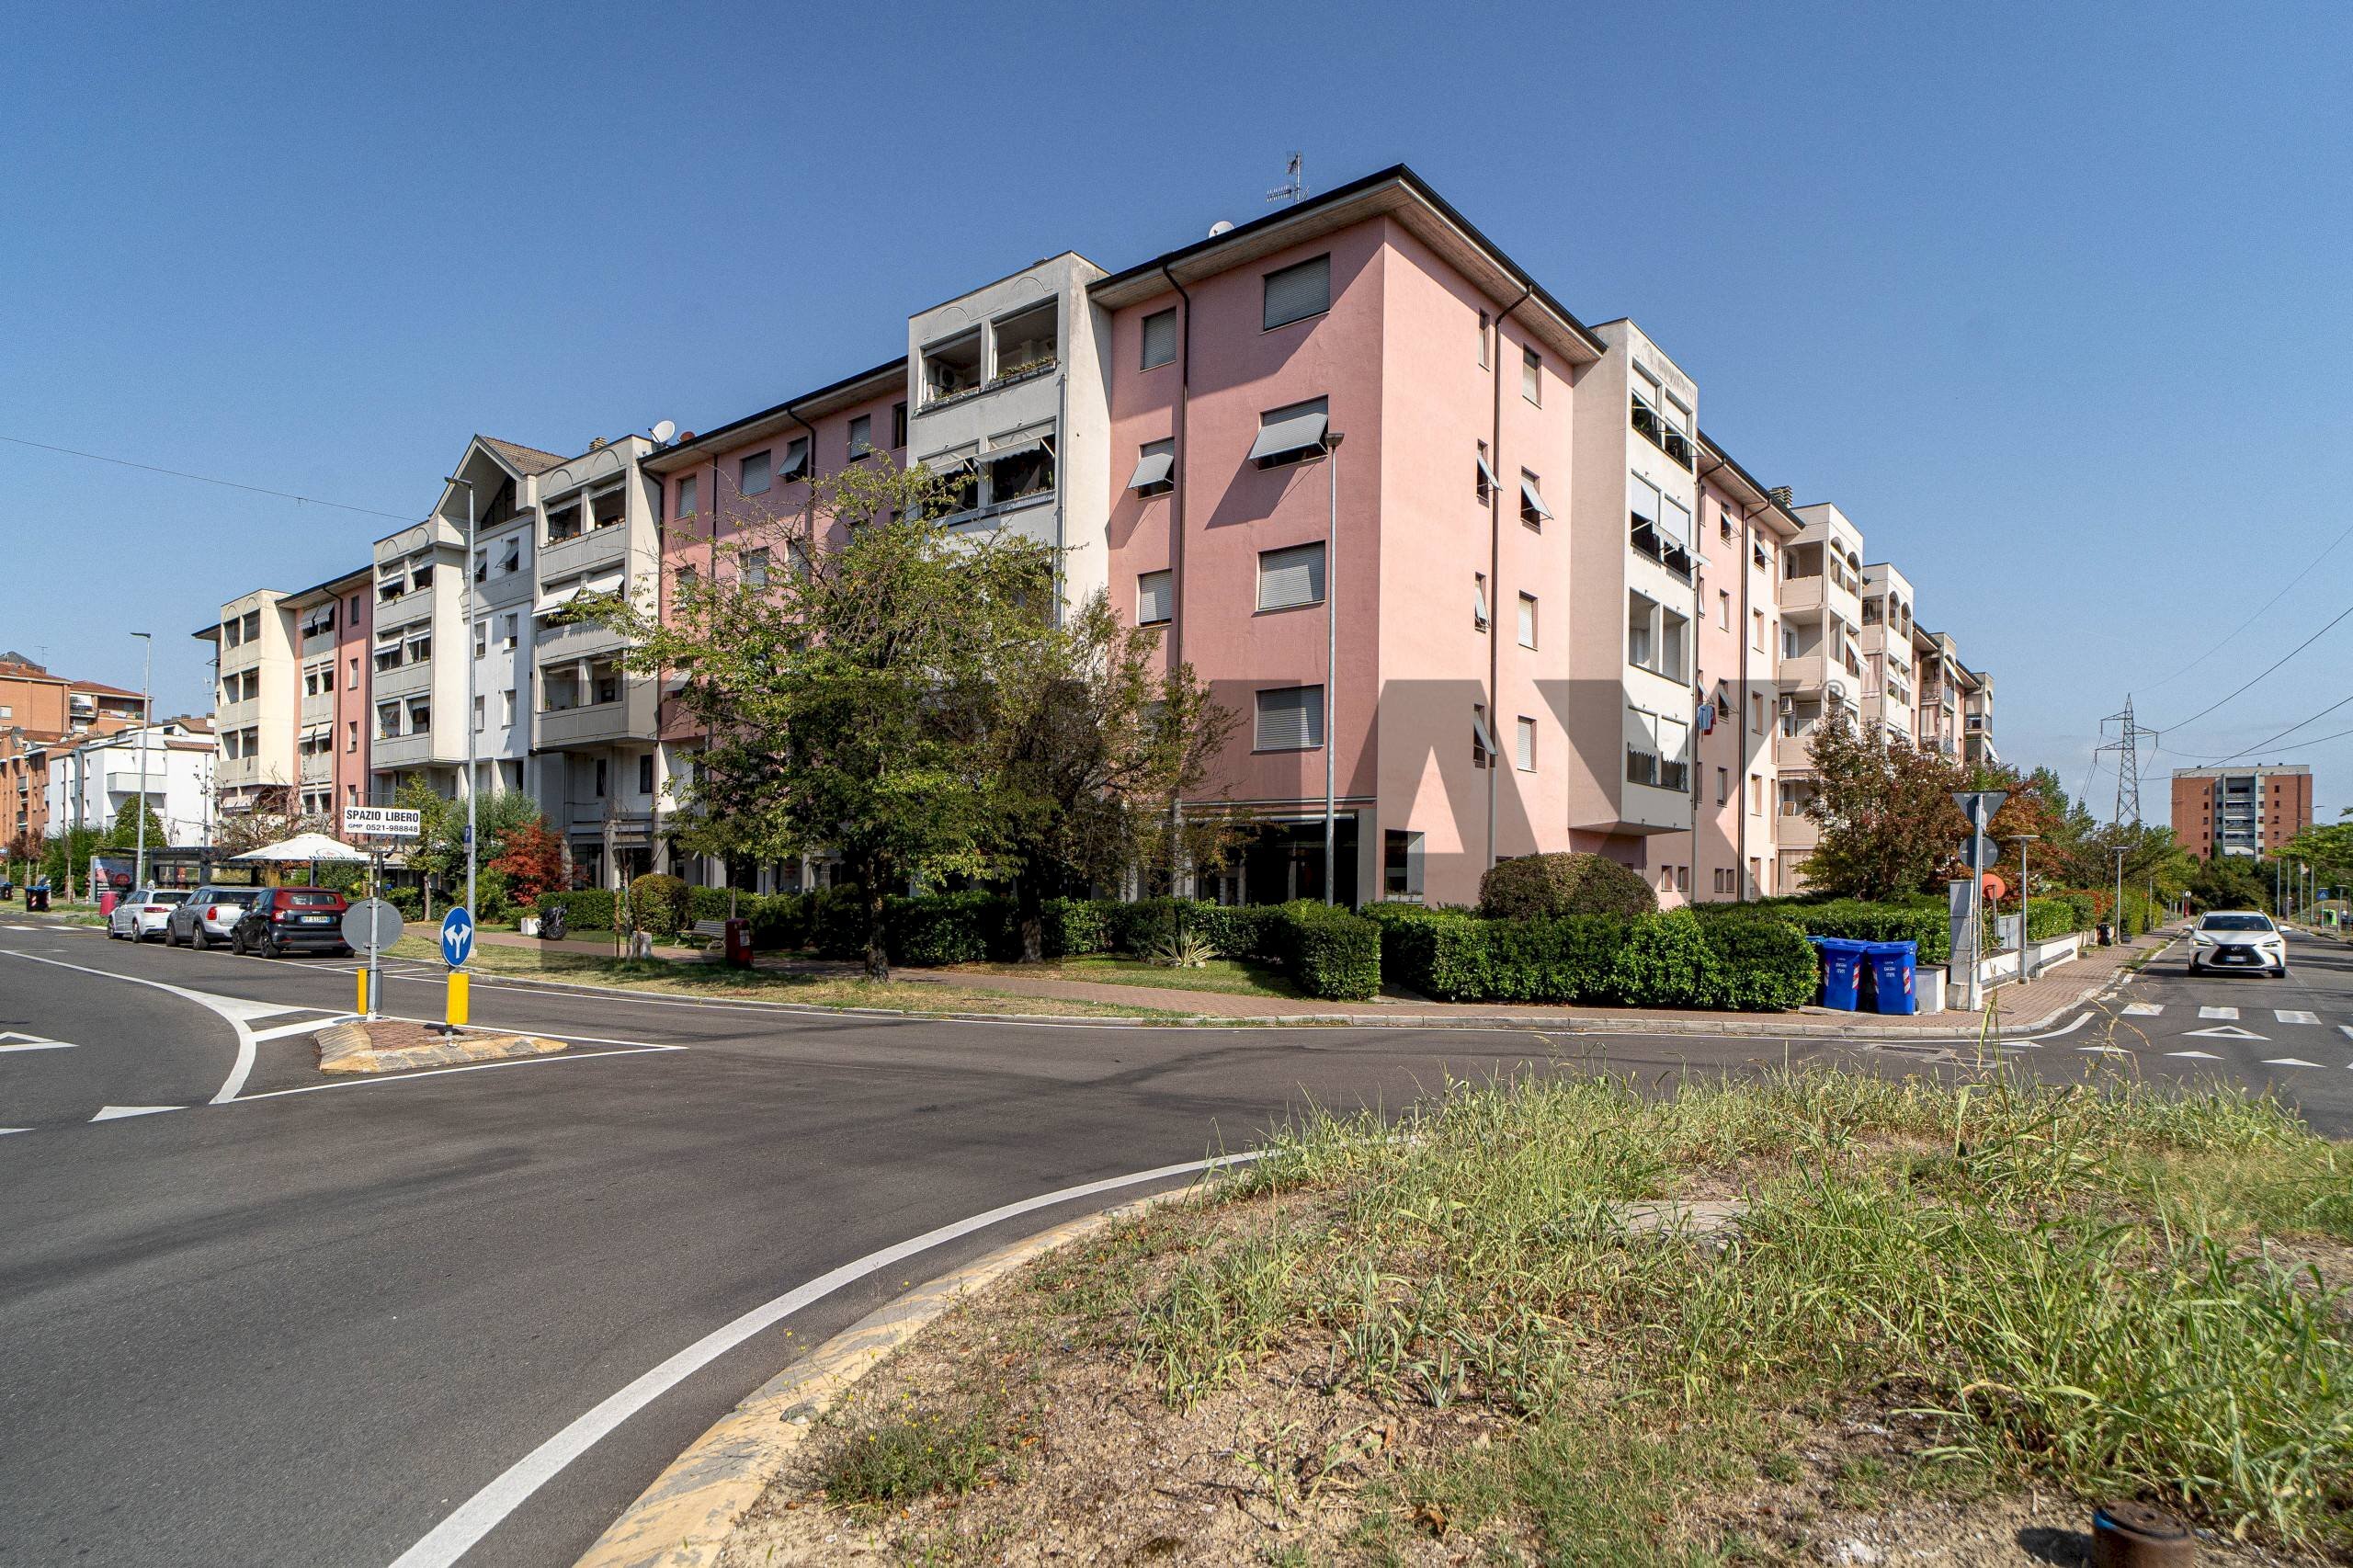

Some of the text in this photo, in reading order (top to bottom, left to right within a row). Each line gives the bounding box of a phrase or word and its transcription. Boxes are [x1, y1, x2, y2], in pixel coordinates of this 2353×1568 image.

[347, 810, 419, 823] SPAZIO LIBERO
[366, 824, 418, 833] 0521-988848
